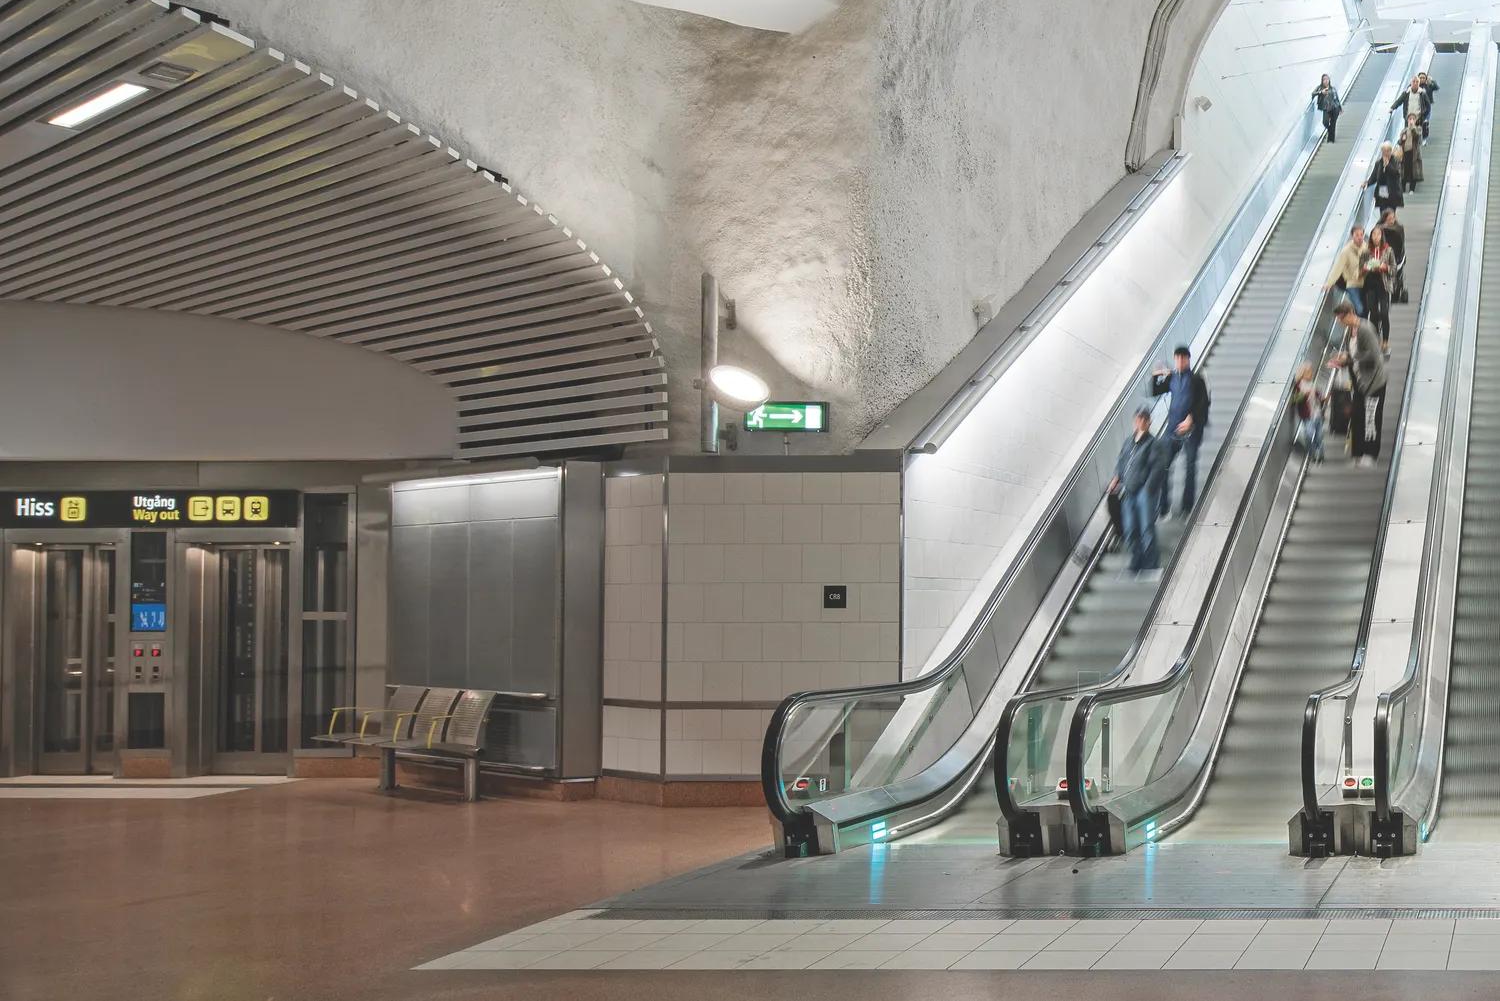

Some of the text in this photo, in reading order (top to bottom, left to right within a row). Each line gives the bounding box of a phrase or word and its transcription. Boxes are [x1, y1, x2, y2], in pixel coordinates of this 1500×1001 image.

[16, 497, 54, 516] Hiss
[133, 495, 176, 510] Utgång
[133, 509, 180, 523] Way out
